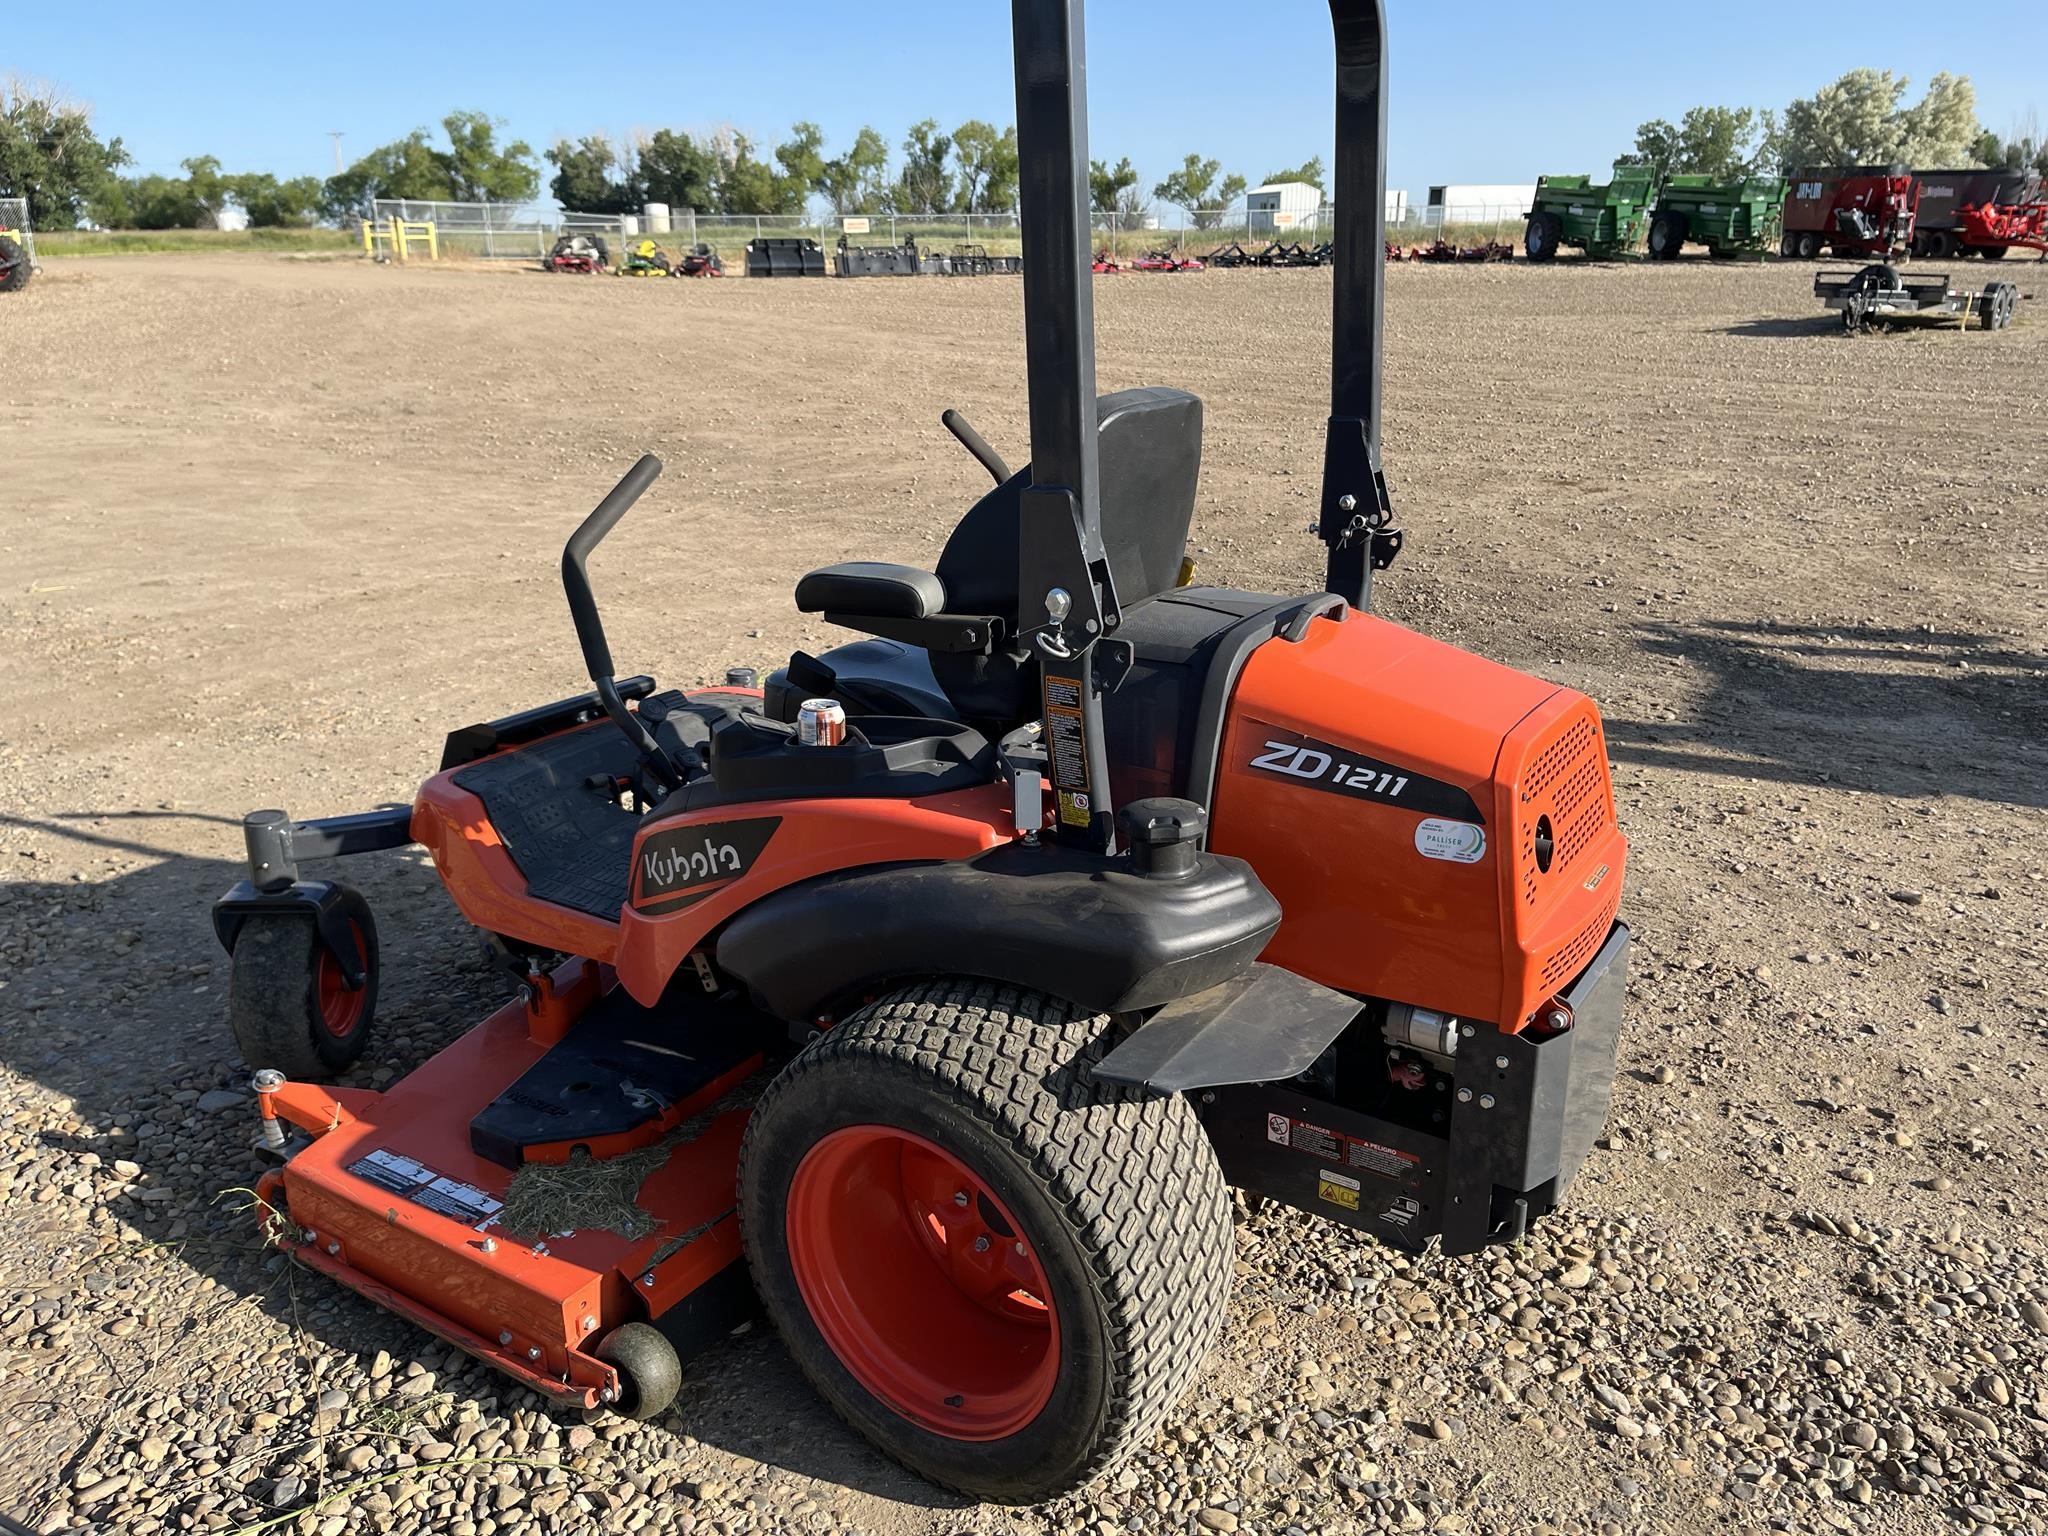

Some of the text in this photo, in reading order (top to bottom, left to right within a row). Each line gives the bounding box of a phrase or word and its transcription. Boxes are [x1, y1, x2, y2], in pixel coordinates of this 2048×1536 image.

[1250, 740, 1409, 797] ZD 1211
[1426, 834, 1462, 847] PALLISER
[644, 838, 741, 886] Kubota
[1305, 1123, 1331, 1136] DANGER
[1369, 1142, 1397, 1156] PELIGRO
